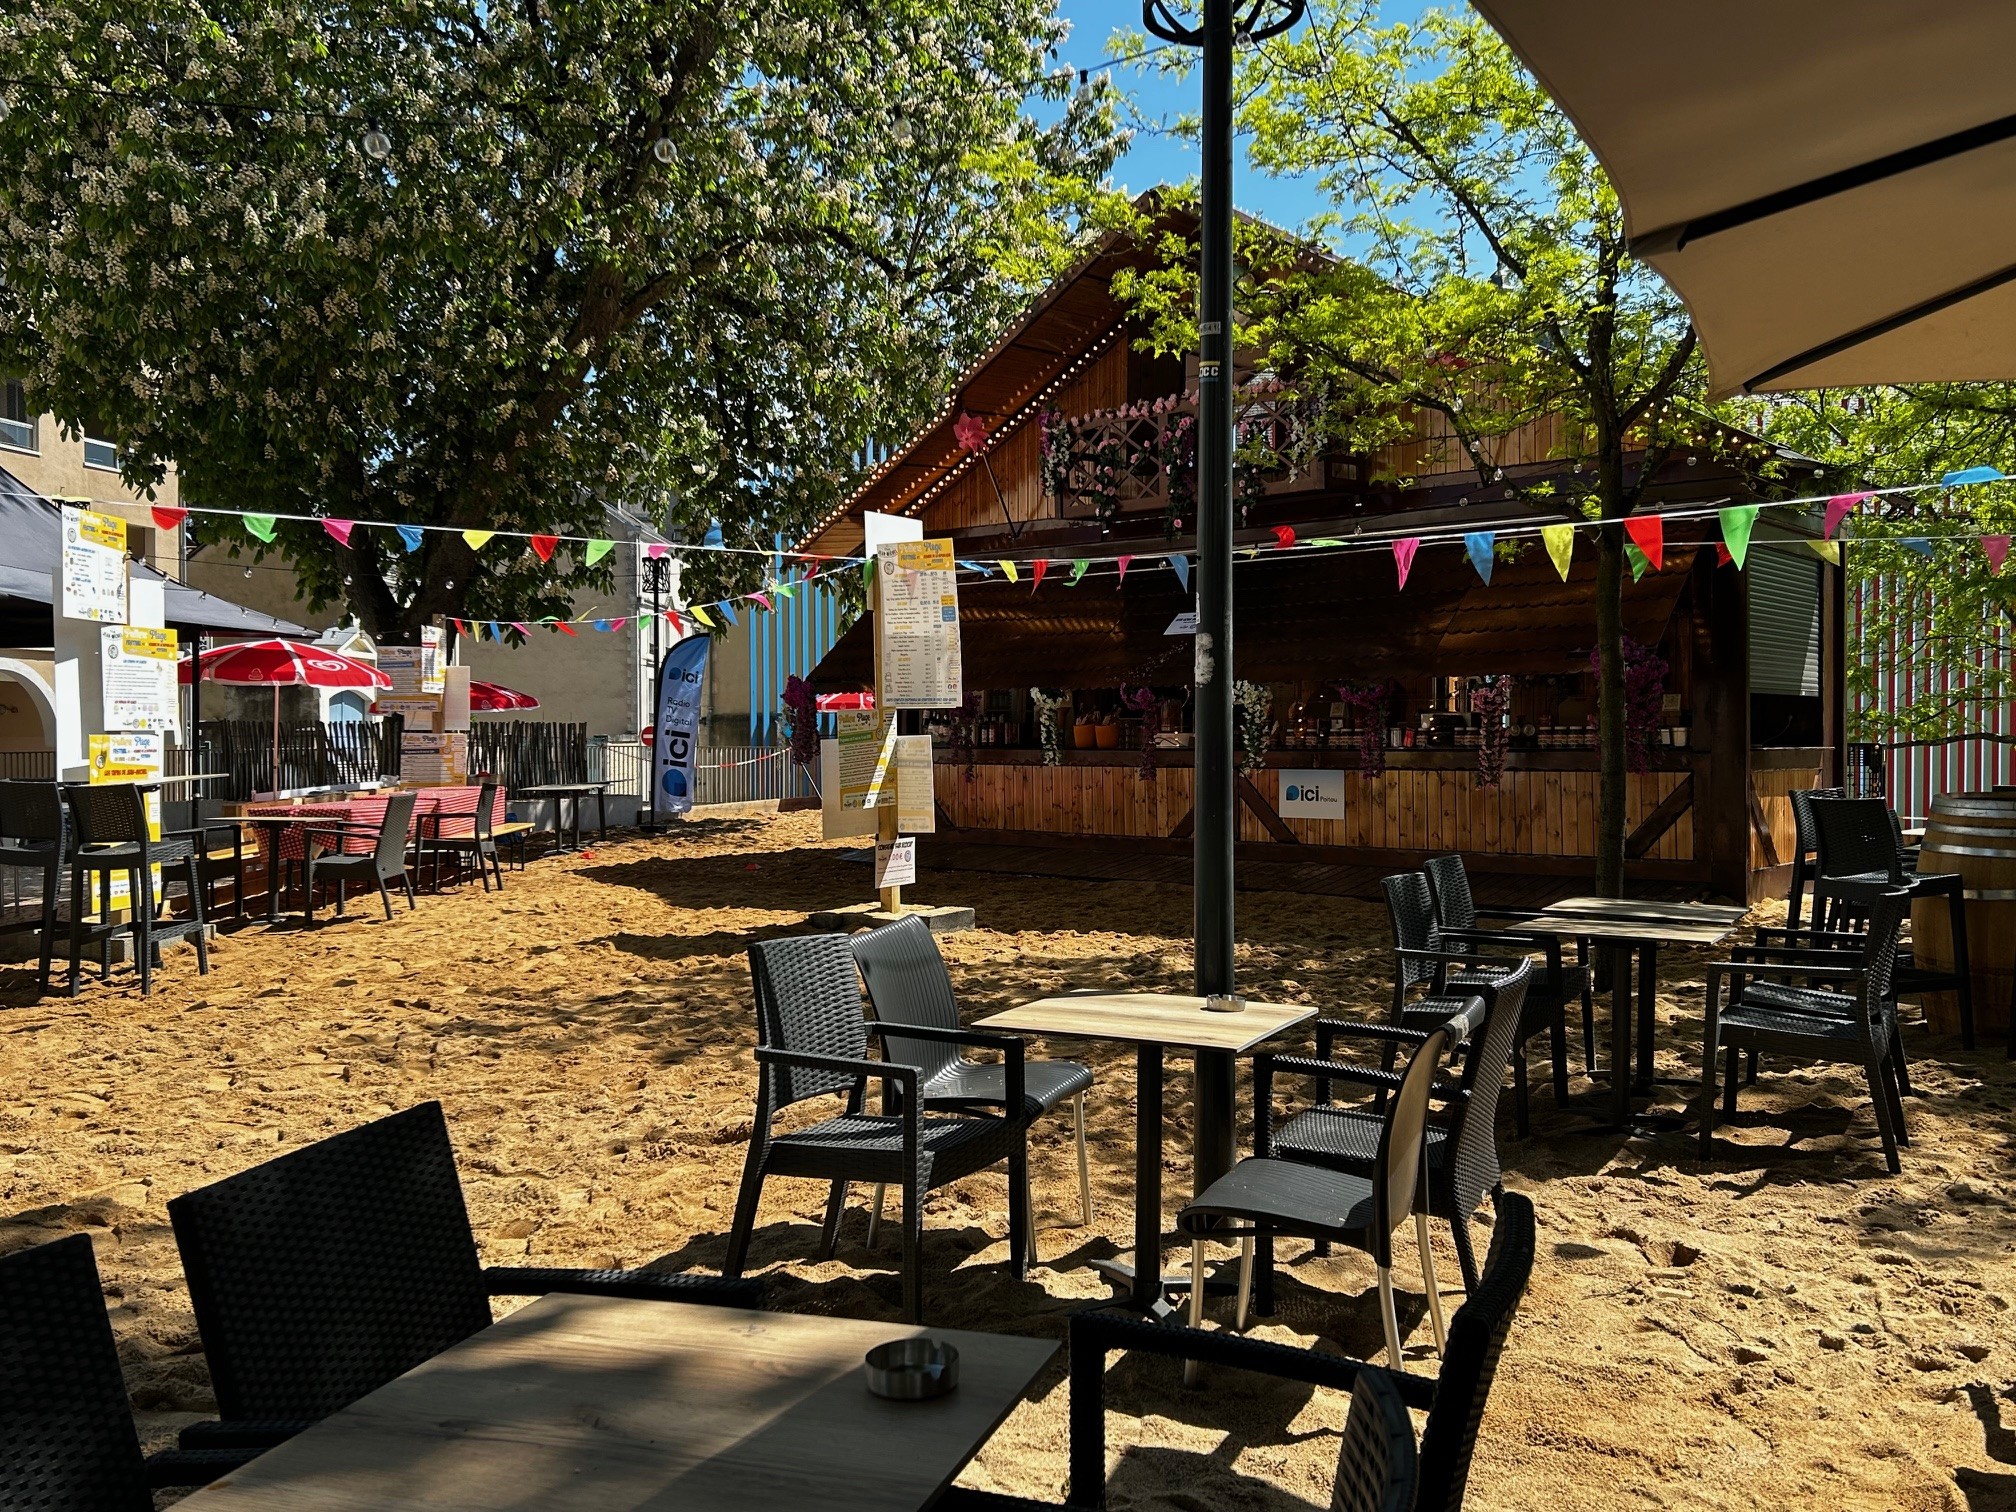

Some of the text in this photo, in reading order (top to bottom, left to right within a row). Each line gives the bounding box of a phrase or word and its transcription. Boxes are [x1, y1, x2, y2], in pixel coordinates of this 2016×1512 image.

[681, 668, 699, 684] ici
[667, 696, 690, 708] Radio
[667, 706, 677, 715] TV
[665, 715, 692, 727] Digital
[662, 729, 691, 768] ici
[1300, 785, 1319, 802] ici
